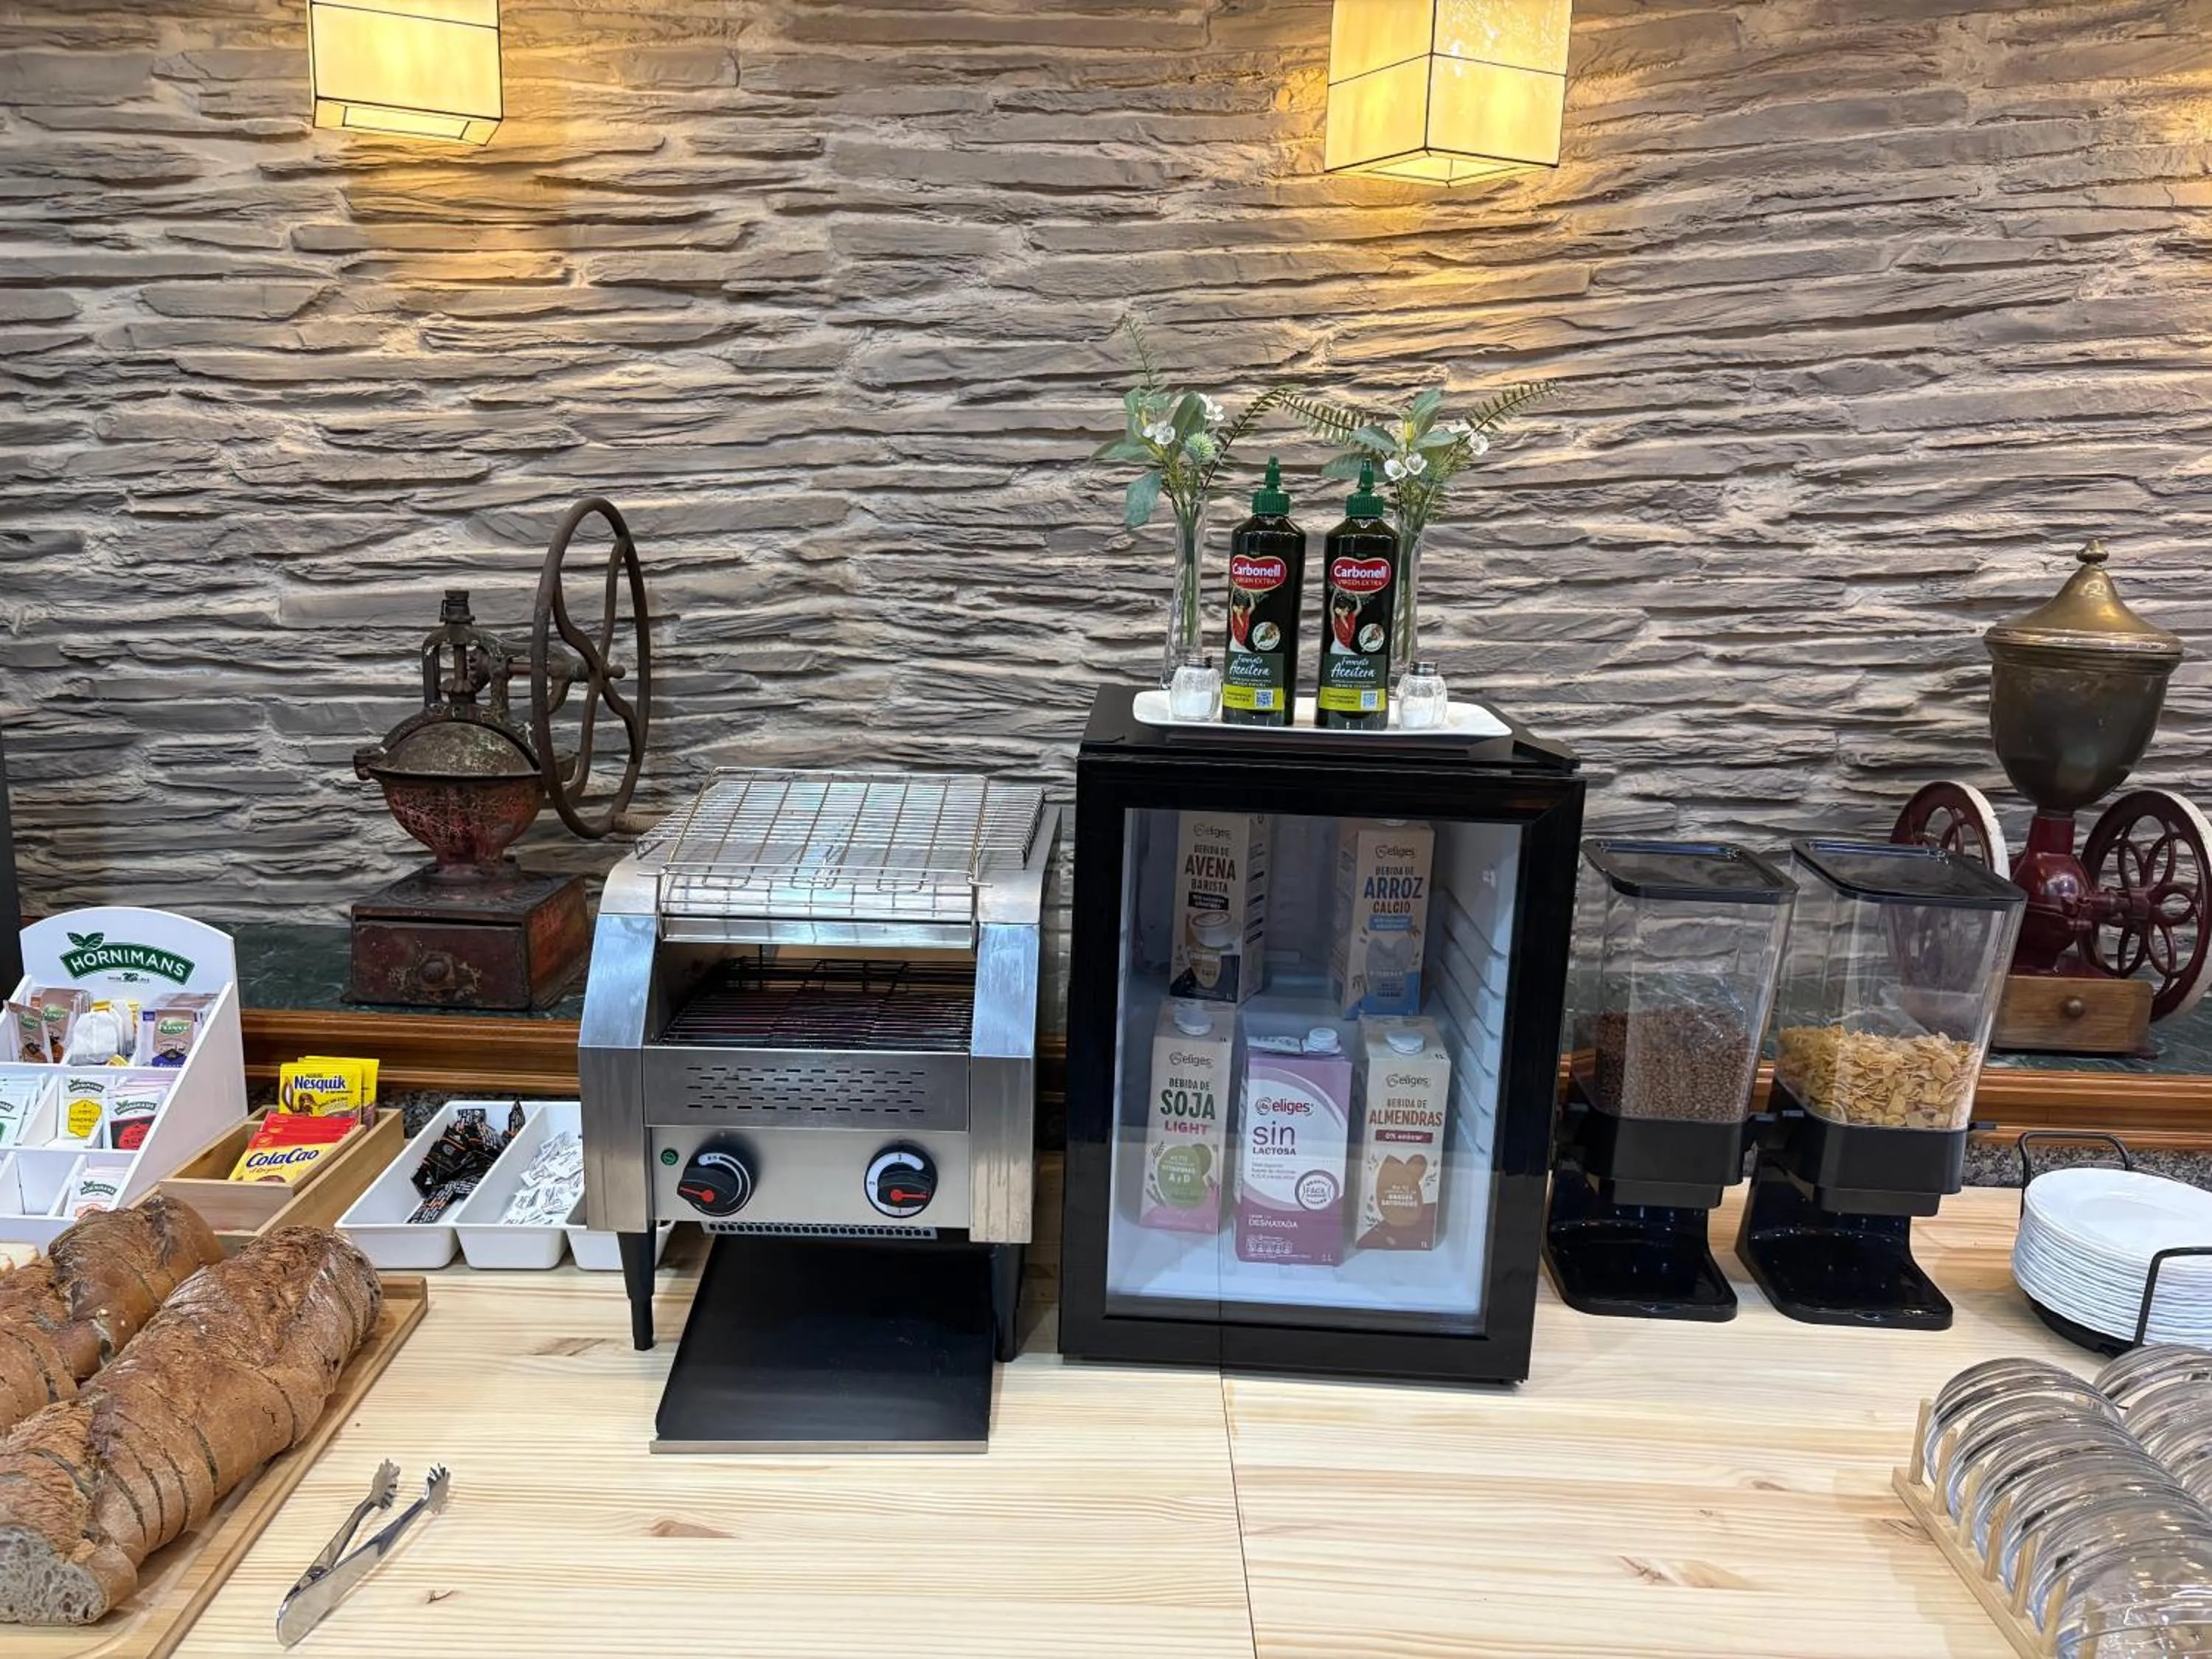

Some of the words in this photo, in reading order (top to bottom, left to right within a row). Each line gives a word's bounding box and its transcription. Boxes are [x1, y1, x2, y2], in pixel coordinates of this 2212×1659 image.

[1232, 563, 1281, 577] Carbonell
[1334, 565, 1387, 579] Carbonell
[1331, 661, 1376, 677] Aceitera
[1185, 854, 1237, 881] AVENA
[1191, 878, 1228, 894] BARISTA
[1363, 876, 1424, 899] ARROZ
[1373, 901, 1411, 914] CALCIO
[70, 949, 186, 977] HORNIMANS
[294, 1074, 346, 1093] Nesquik
[1168, 1077, 1198, 1089] BEBIDA
[1200, 1080, 1211, 1091] DE
[1160, 1089, 1216, 1119] SOJA
[1387, 1097, 1415, 1107] BEBIDA
[1416, 1099, 1428, 1109] DE
[1368, 1109, 1443, 1127] ALMENDRAS
[1164, 1120, 1211, 1135] LIGHT
[1253, 1120, 1295, 1145] sin
[246, 1147, 319, 1167] ColaCao
[1253, 1147, 1297, 1155] LACTOSA
[1248, 1218, 1298, 1228] DESNATADA
